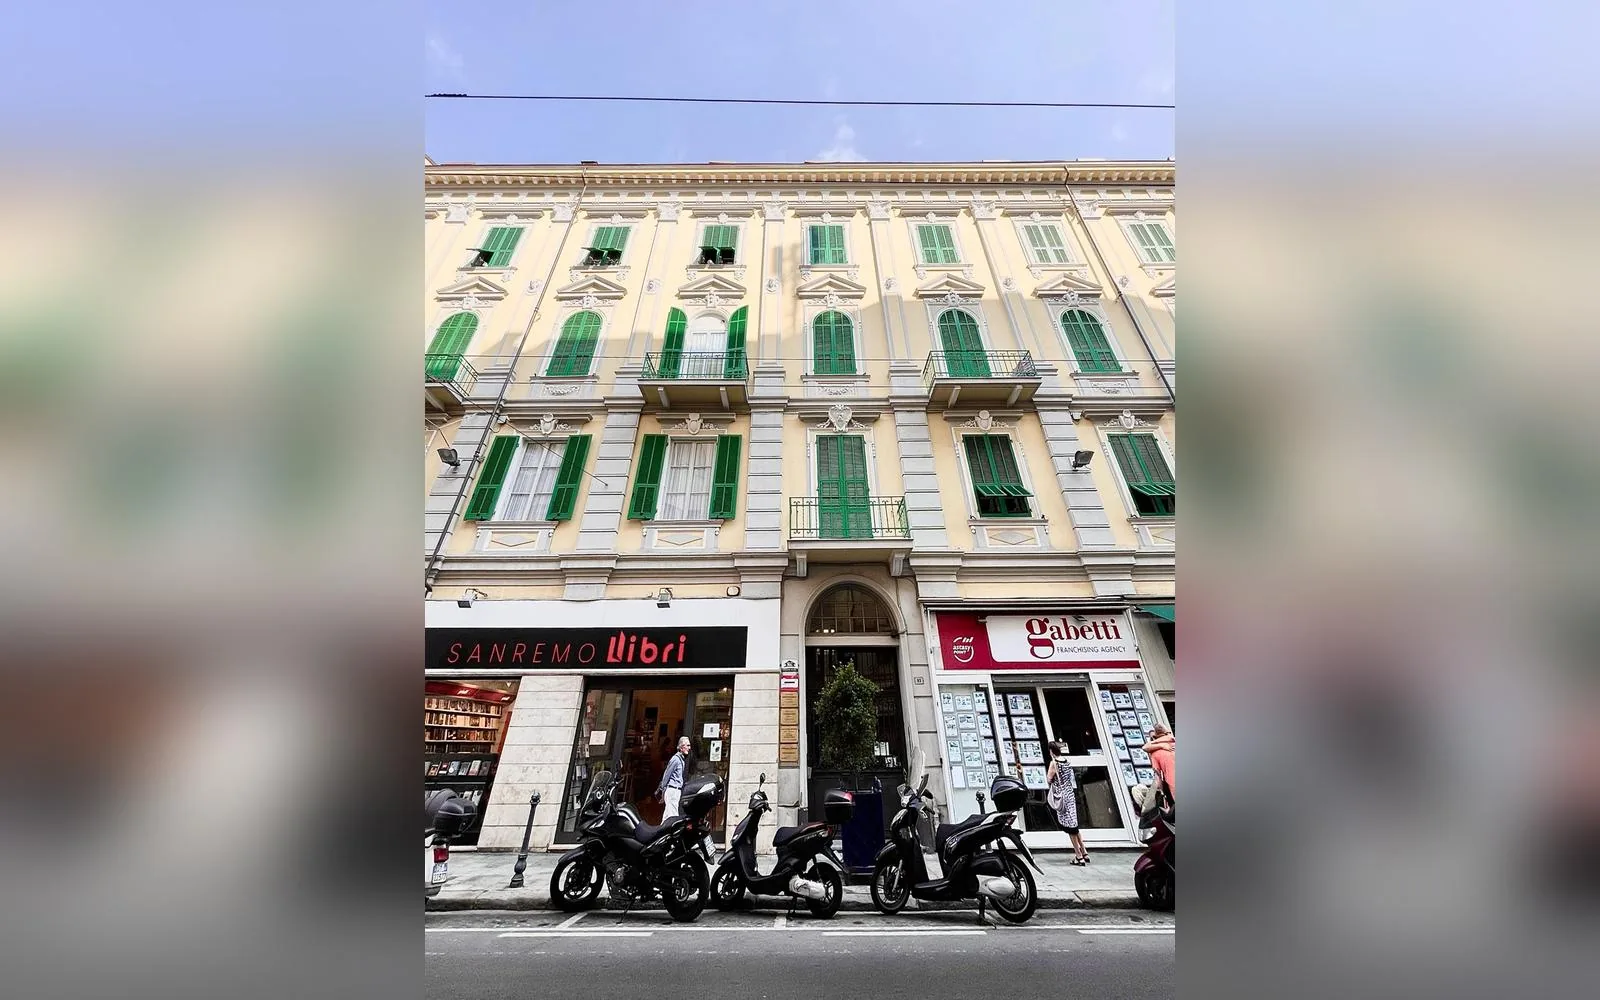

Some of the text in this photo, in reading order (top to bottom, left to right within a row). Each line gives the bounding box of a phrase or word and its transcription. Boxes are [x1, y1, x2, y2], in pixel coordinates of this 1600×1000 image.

[1025, 617, 1123, 659] gabetti
[1056, 645, 1126, 653] FRANCHISING AGENCY
[447, 642, 596, 664] SANREMO
